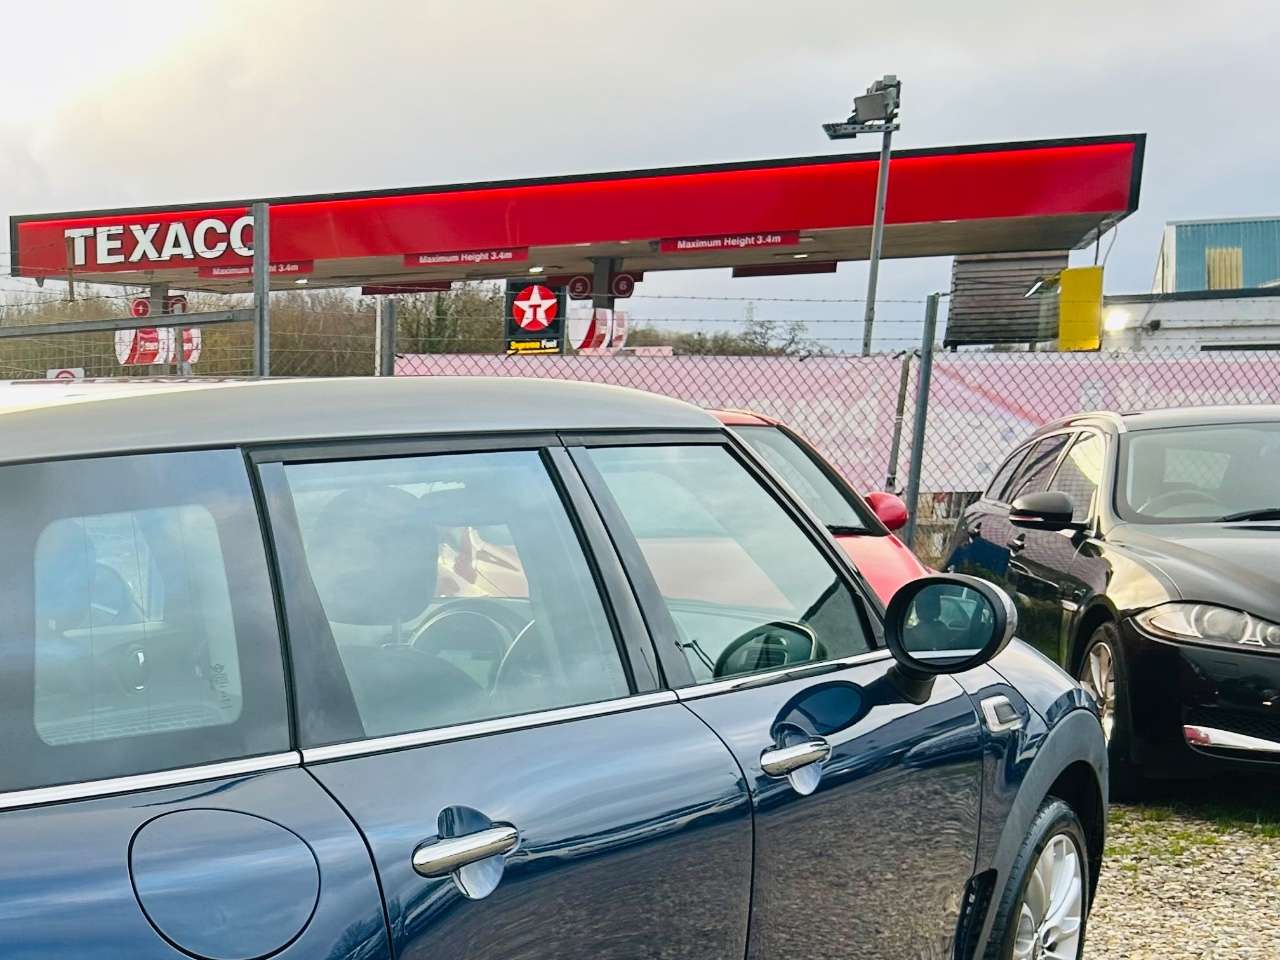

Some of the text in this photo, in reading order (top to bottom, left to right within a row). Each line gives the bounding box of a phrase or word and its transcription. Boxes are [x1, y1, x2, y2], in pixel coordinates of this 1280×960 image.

[677, 234, 782, 249] Maximum Height 3.4m
[419, 250, 513, 264] Maximum Height 3.4m
